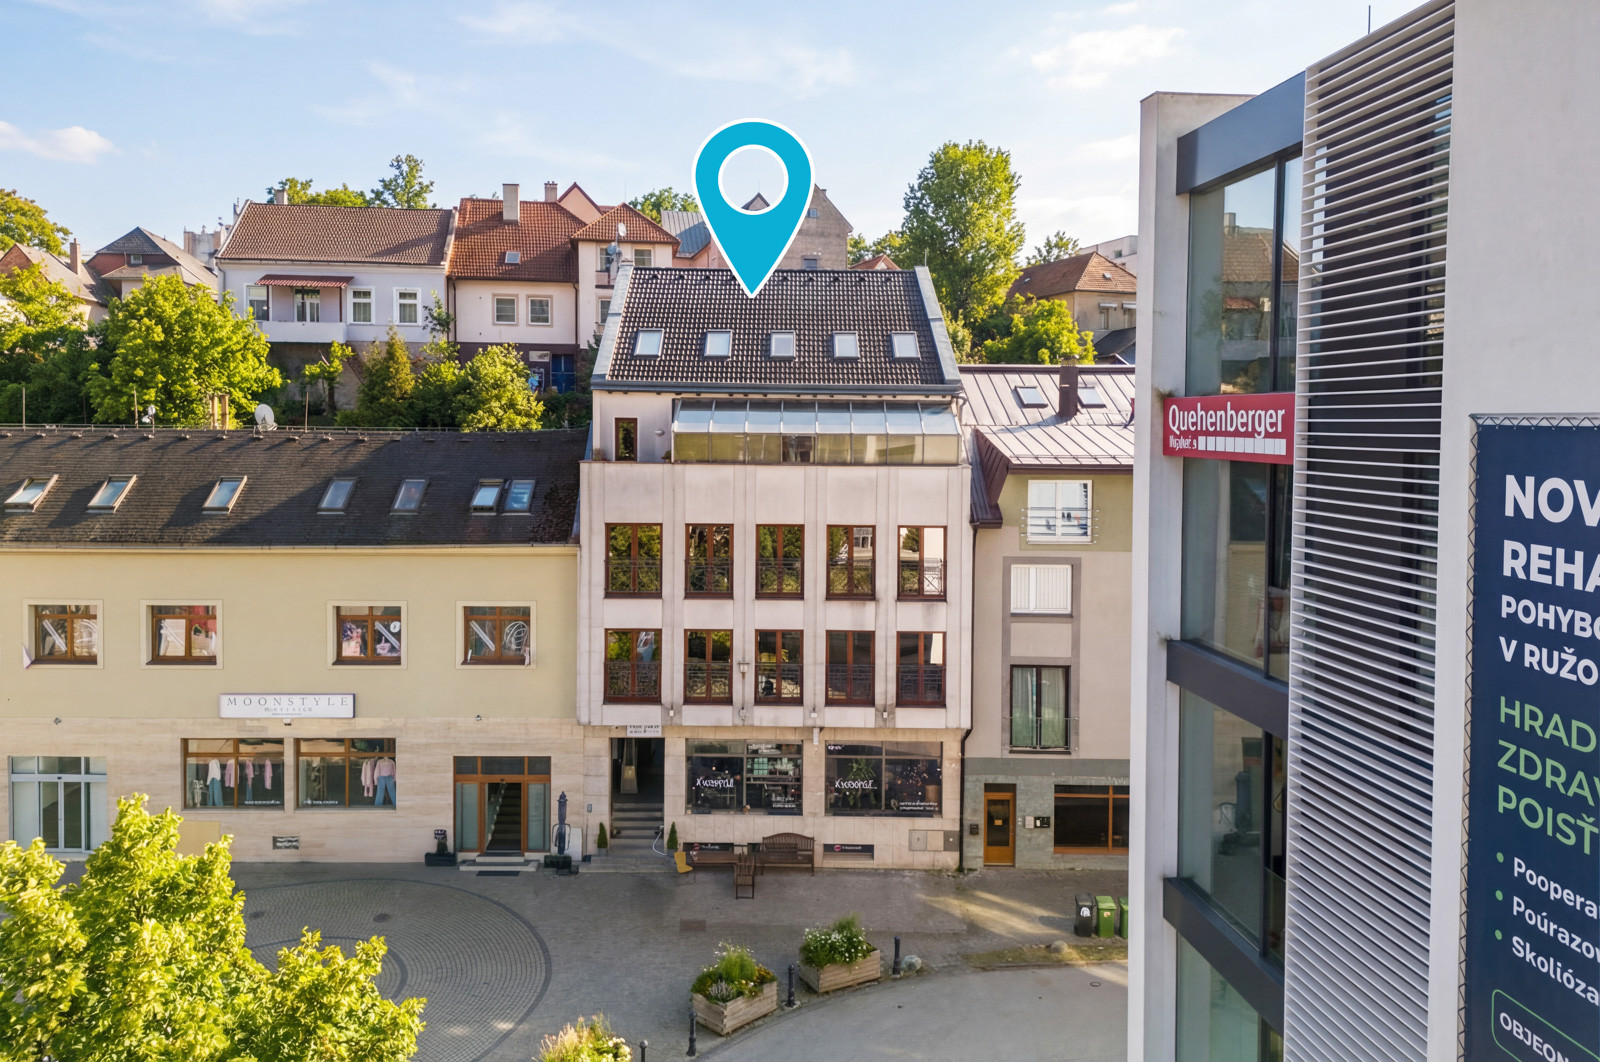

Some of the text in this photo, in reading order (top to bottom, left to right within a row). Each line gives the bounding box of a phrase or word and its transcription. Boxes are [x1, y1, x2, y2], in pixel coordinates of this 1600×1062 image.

[1168, 401, 1286, 439] Quehenberger
[1504, 474, 1600, 527] NOV
[1499, 636, 1599, 686] V RUŽO
[227, 697, 348, 706] MOONSTYLE
[1500, 695, 1598, 753] HRAD
[1497, 739, 1600, 807] ZDRA
[1498, 784, 1599, 856] POISŤ
[1513, 857, 1600, 919] Poopera
[1511, 935, 1600, 1007] Skolióza
